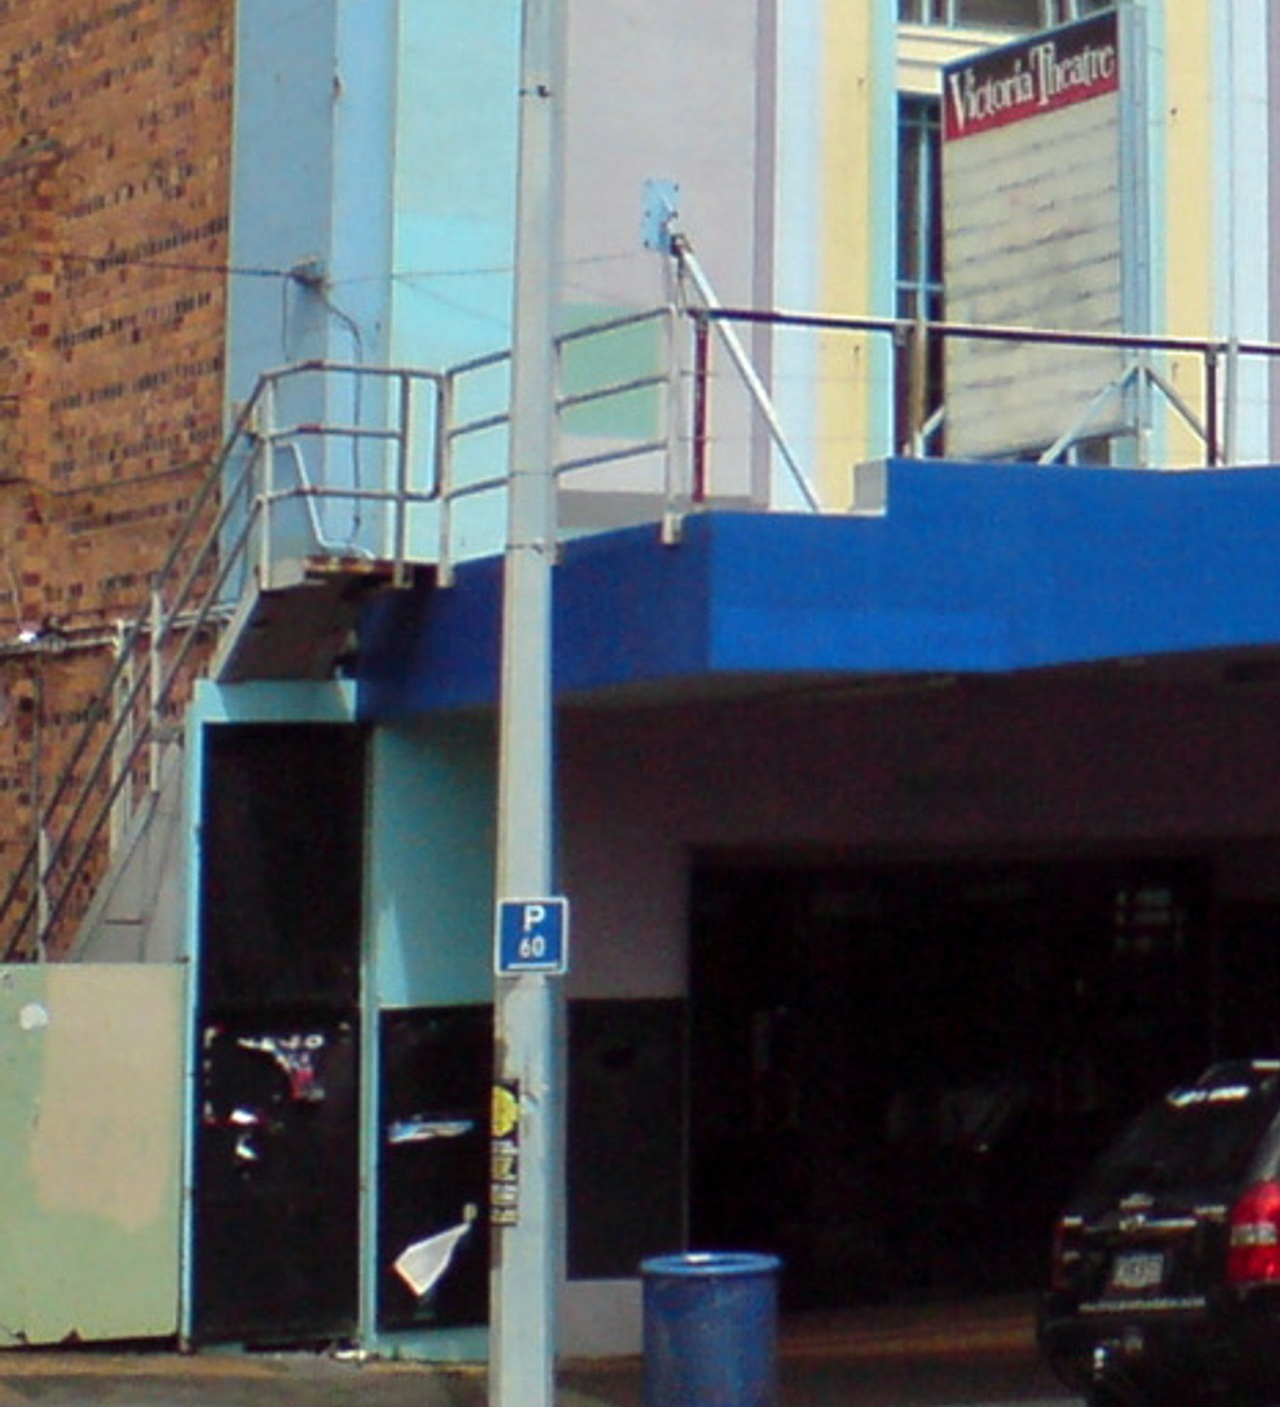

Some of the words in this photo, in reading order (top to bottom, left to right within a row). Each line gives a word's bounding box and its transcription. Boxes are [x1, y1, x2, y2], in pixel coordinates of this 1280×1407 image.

[949, 59, 1034, 132] Victoria
[1029, 41, 1115, 106] Theatre
[523, 904, 546, 932] P
[518, 934, 546, 959] 60
